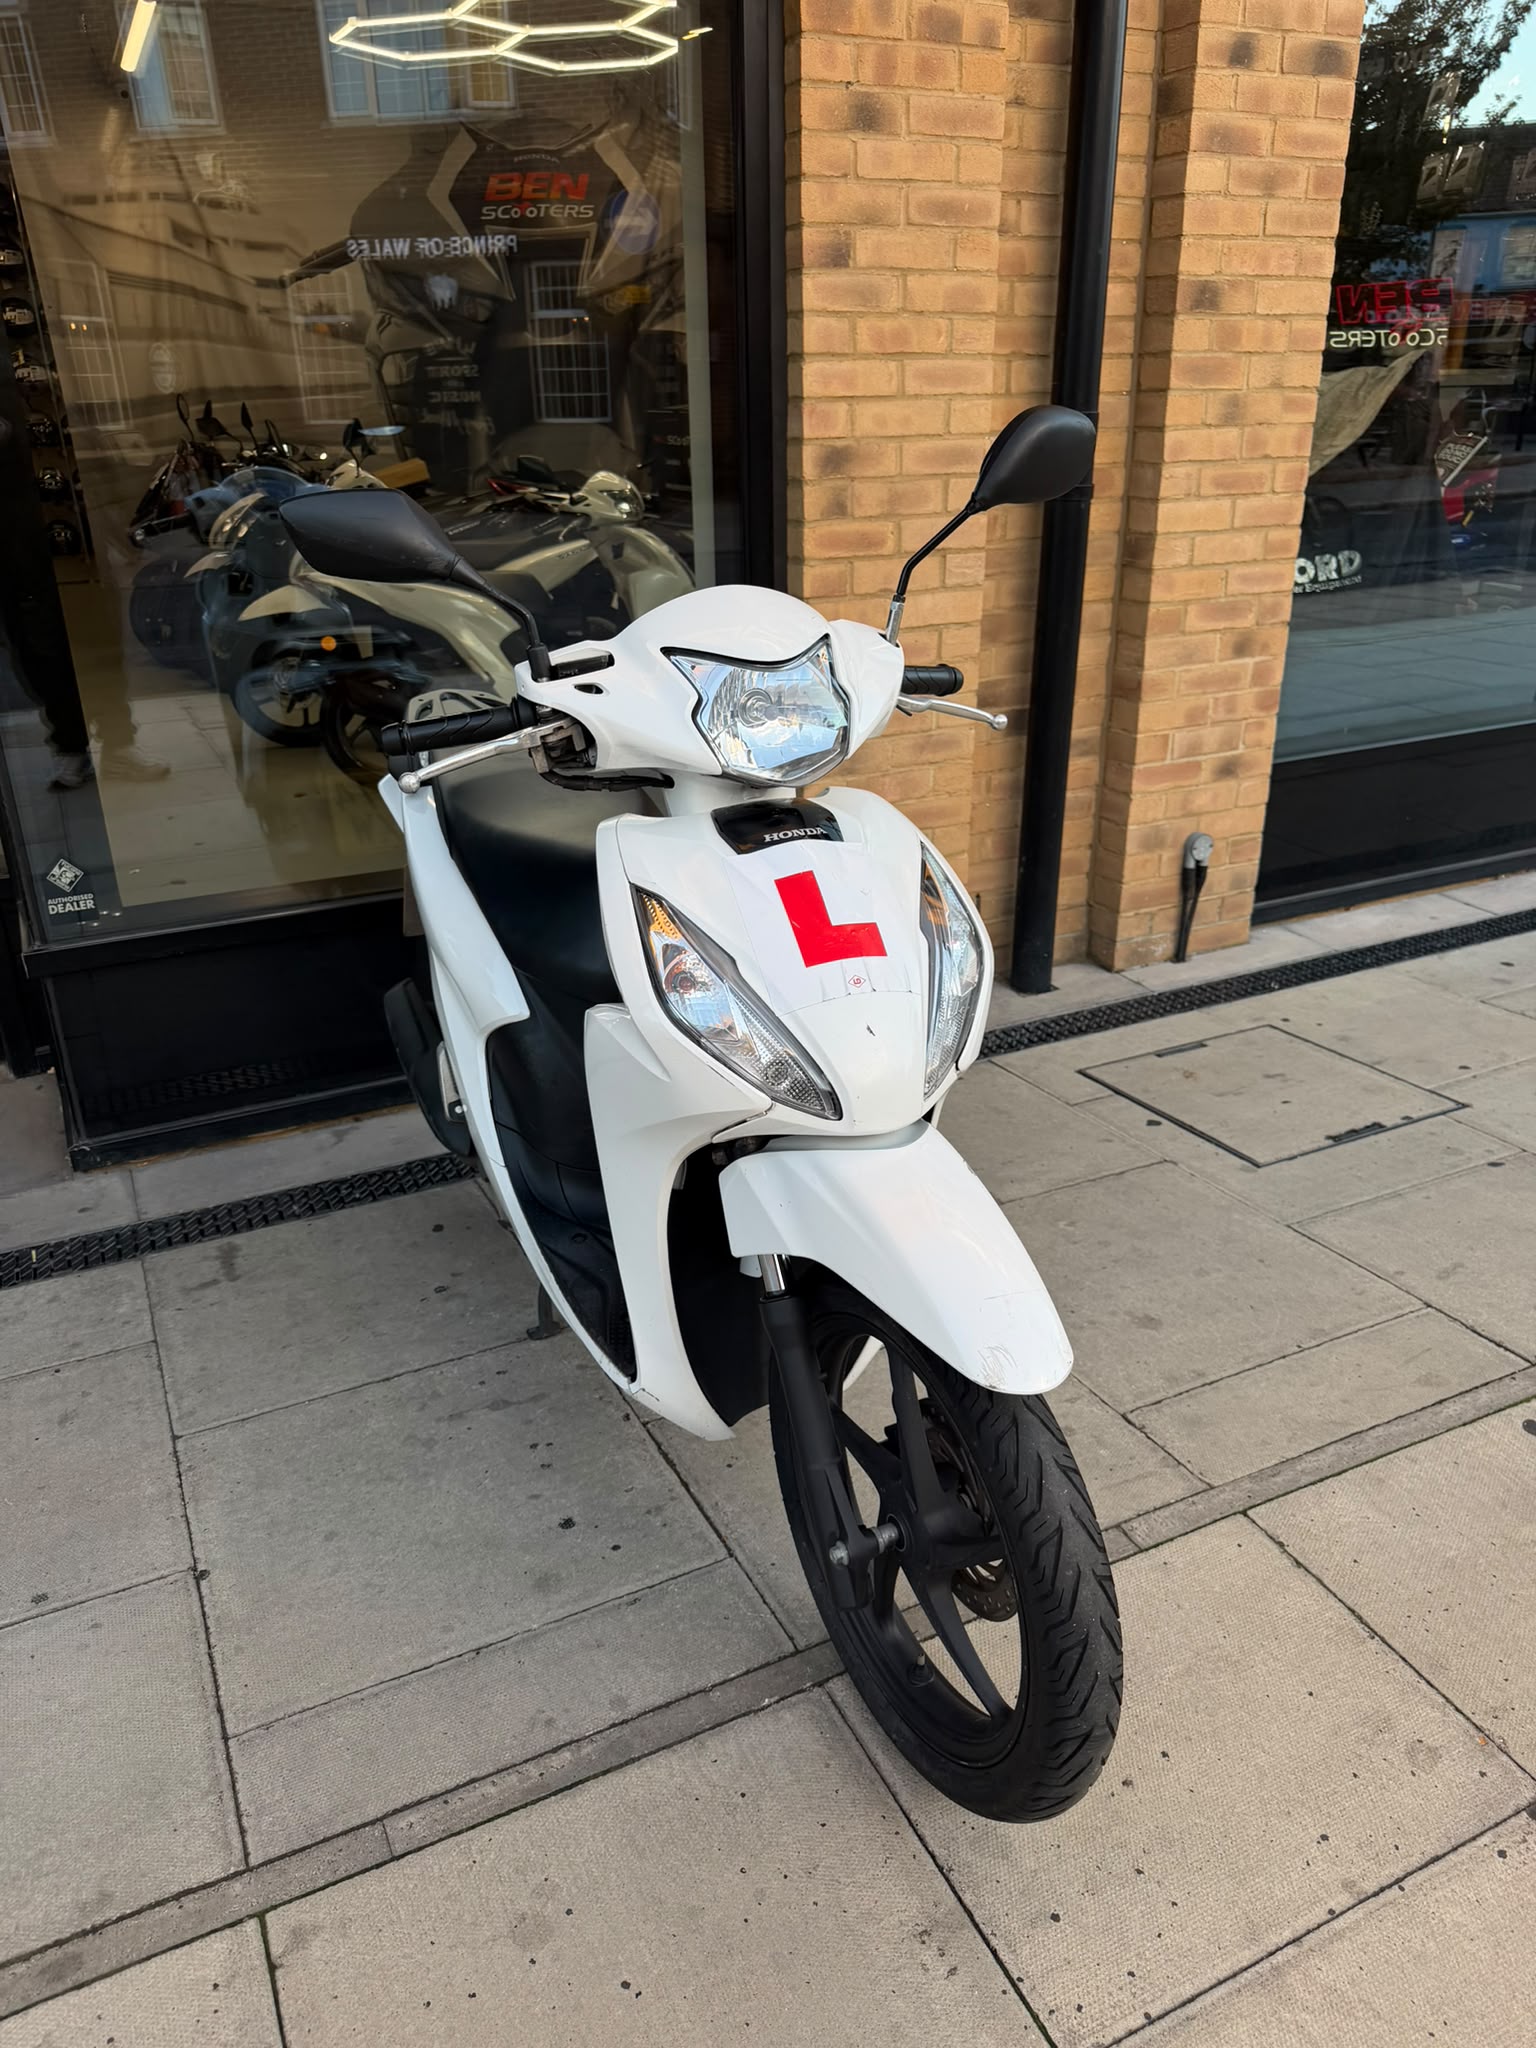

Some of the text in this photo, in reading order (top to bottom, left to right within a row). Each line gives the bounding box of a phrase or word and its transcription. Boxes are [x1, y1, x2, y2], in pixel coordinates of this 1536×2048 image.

[484, 171, 589, 201] BEN
[763, 827, 827, 842] HONDA
[48, 893, 94, 905] AUTHORISED
[48, 900, 96, 915] DEALER
[774, 870, 888, 968] L
